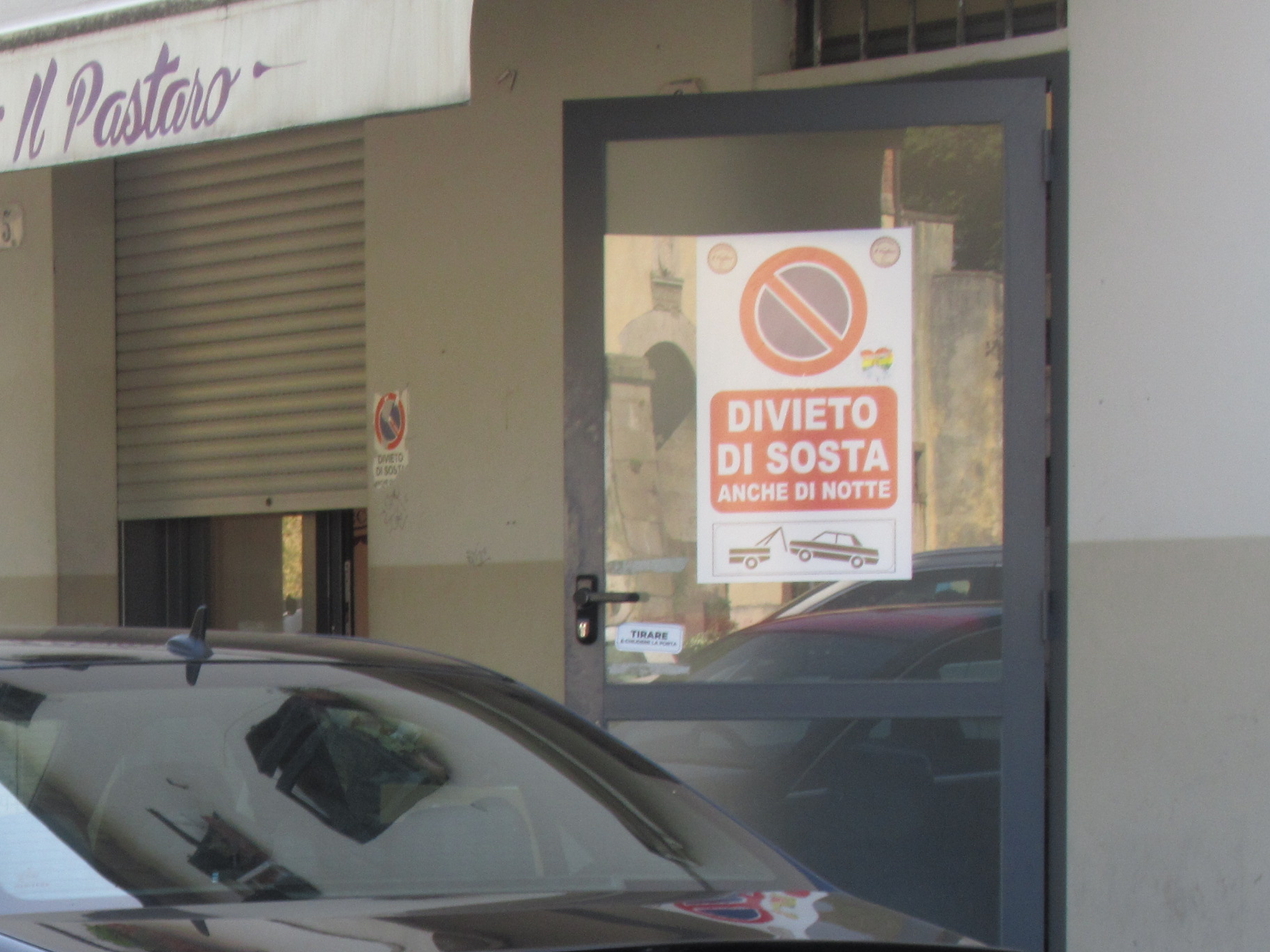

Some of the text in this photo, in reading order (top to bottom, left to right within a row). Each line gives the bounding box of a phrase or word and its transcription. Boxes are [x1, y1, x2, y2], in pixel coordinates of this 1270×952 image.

[65, 41, 242, 154] Pastaro
[727, 395, 879, 433] DIVIETO
[378, 452, 403, 464] DIVIETO
[717, 438, 890, 476] DI SOSTA
[717, 478, 892, 503] ANCHE DI NOTTE
[630, 629, 668, 641] TIRARE
